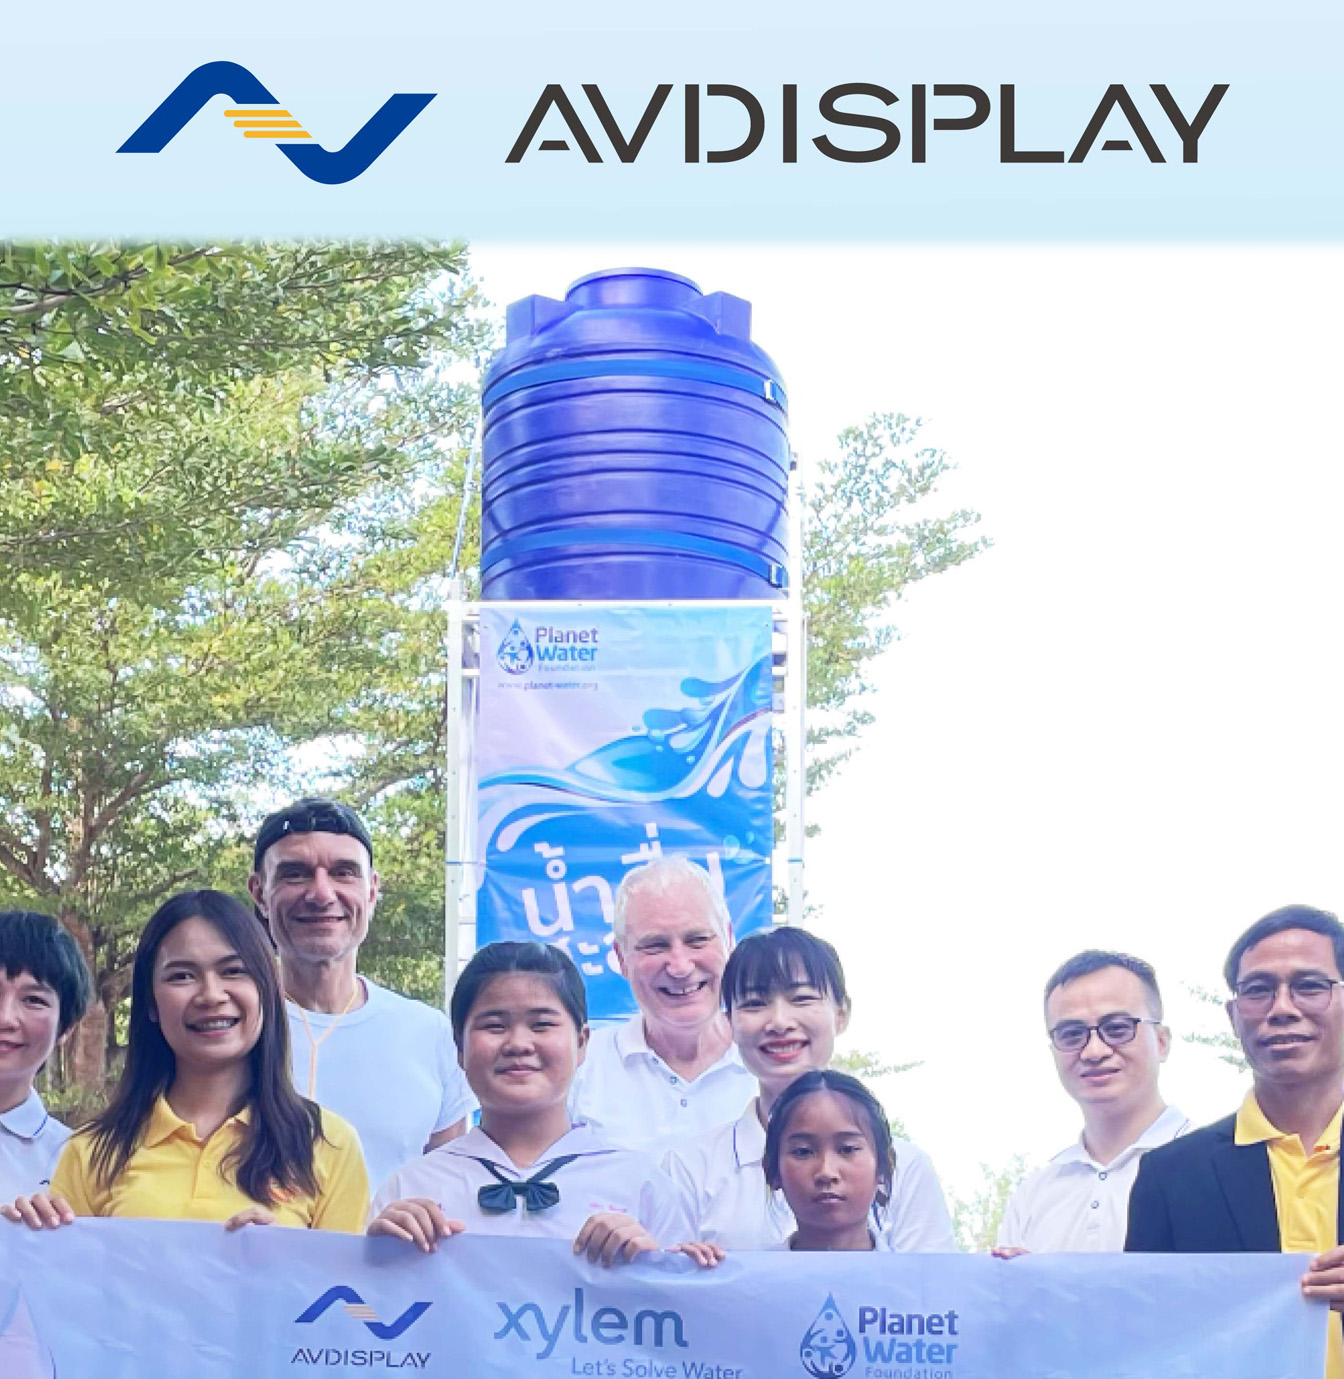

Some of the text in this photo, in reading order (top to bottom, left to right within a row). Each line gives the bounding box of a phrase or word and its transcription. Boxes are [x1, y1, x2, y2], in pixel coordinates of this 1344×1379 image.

[535, 627, 598, 643] Planet
[536, 645, 598, 661] Water
[493, 1287, 688, 1360] xylem
[858, 1306, 959, 1336] Planet
[290, 1348, 432, 1369] AVDISPLAY
[862, 1338, 958, 1365] Water
[621, 1358, 678, 1379] Solve
[865, 1367, 954, 1379] Foundation
